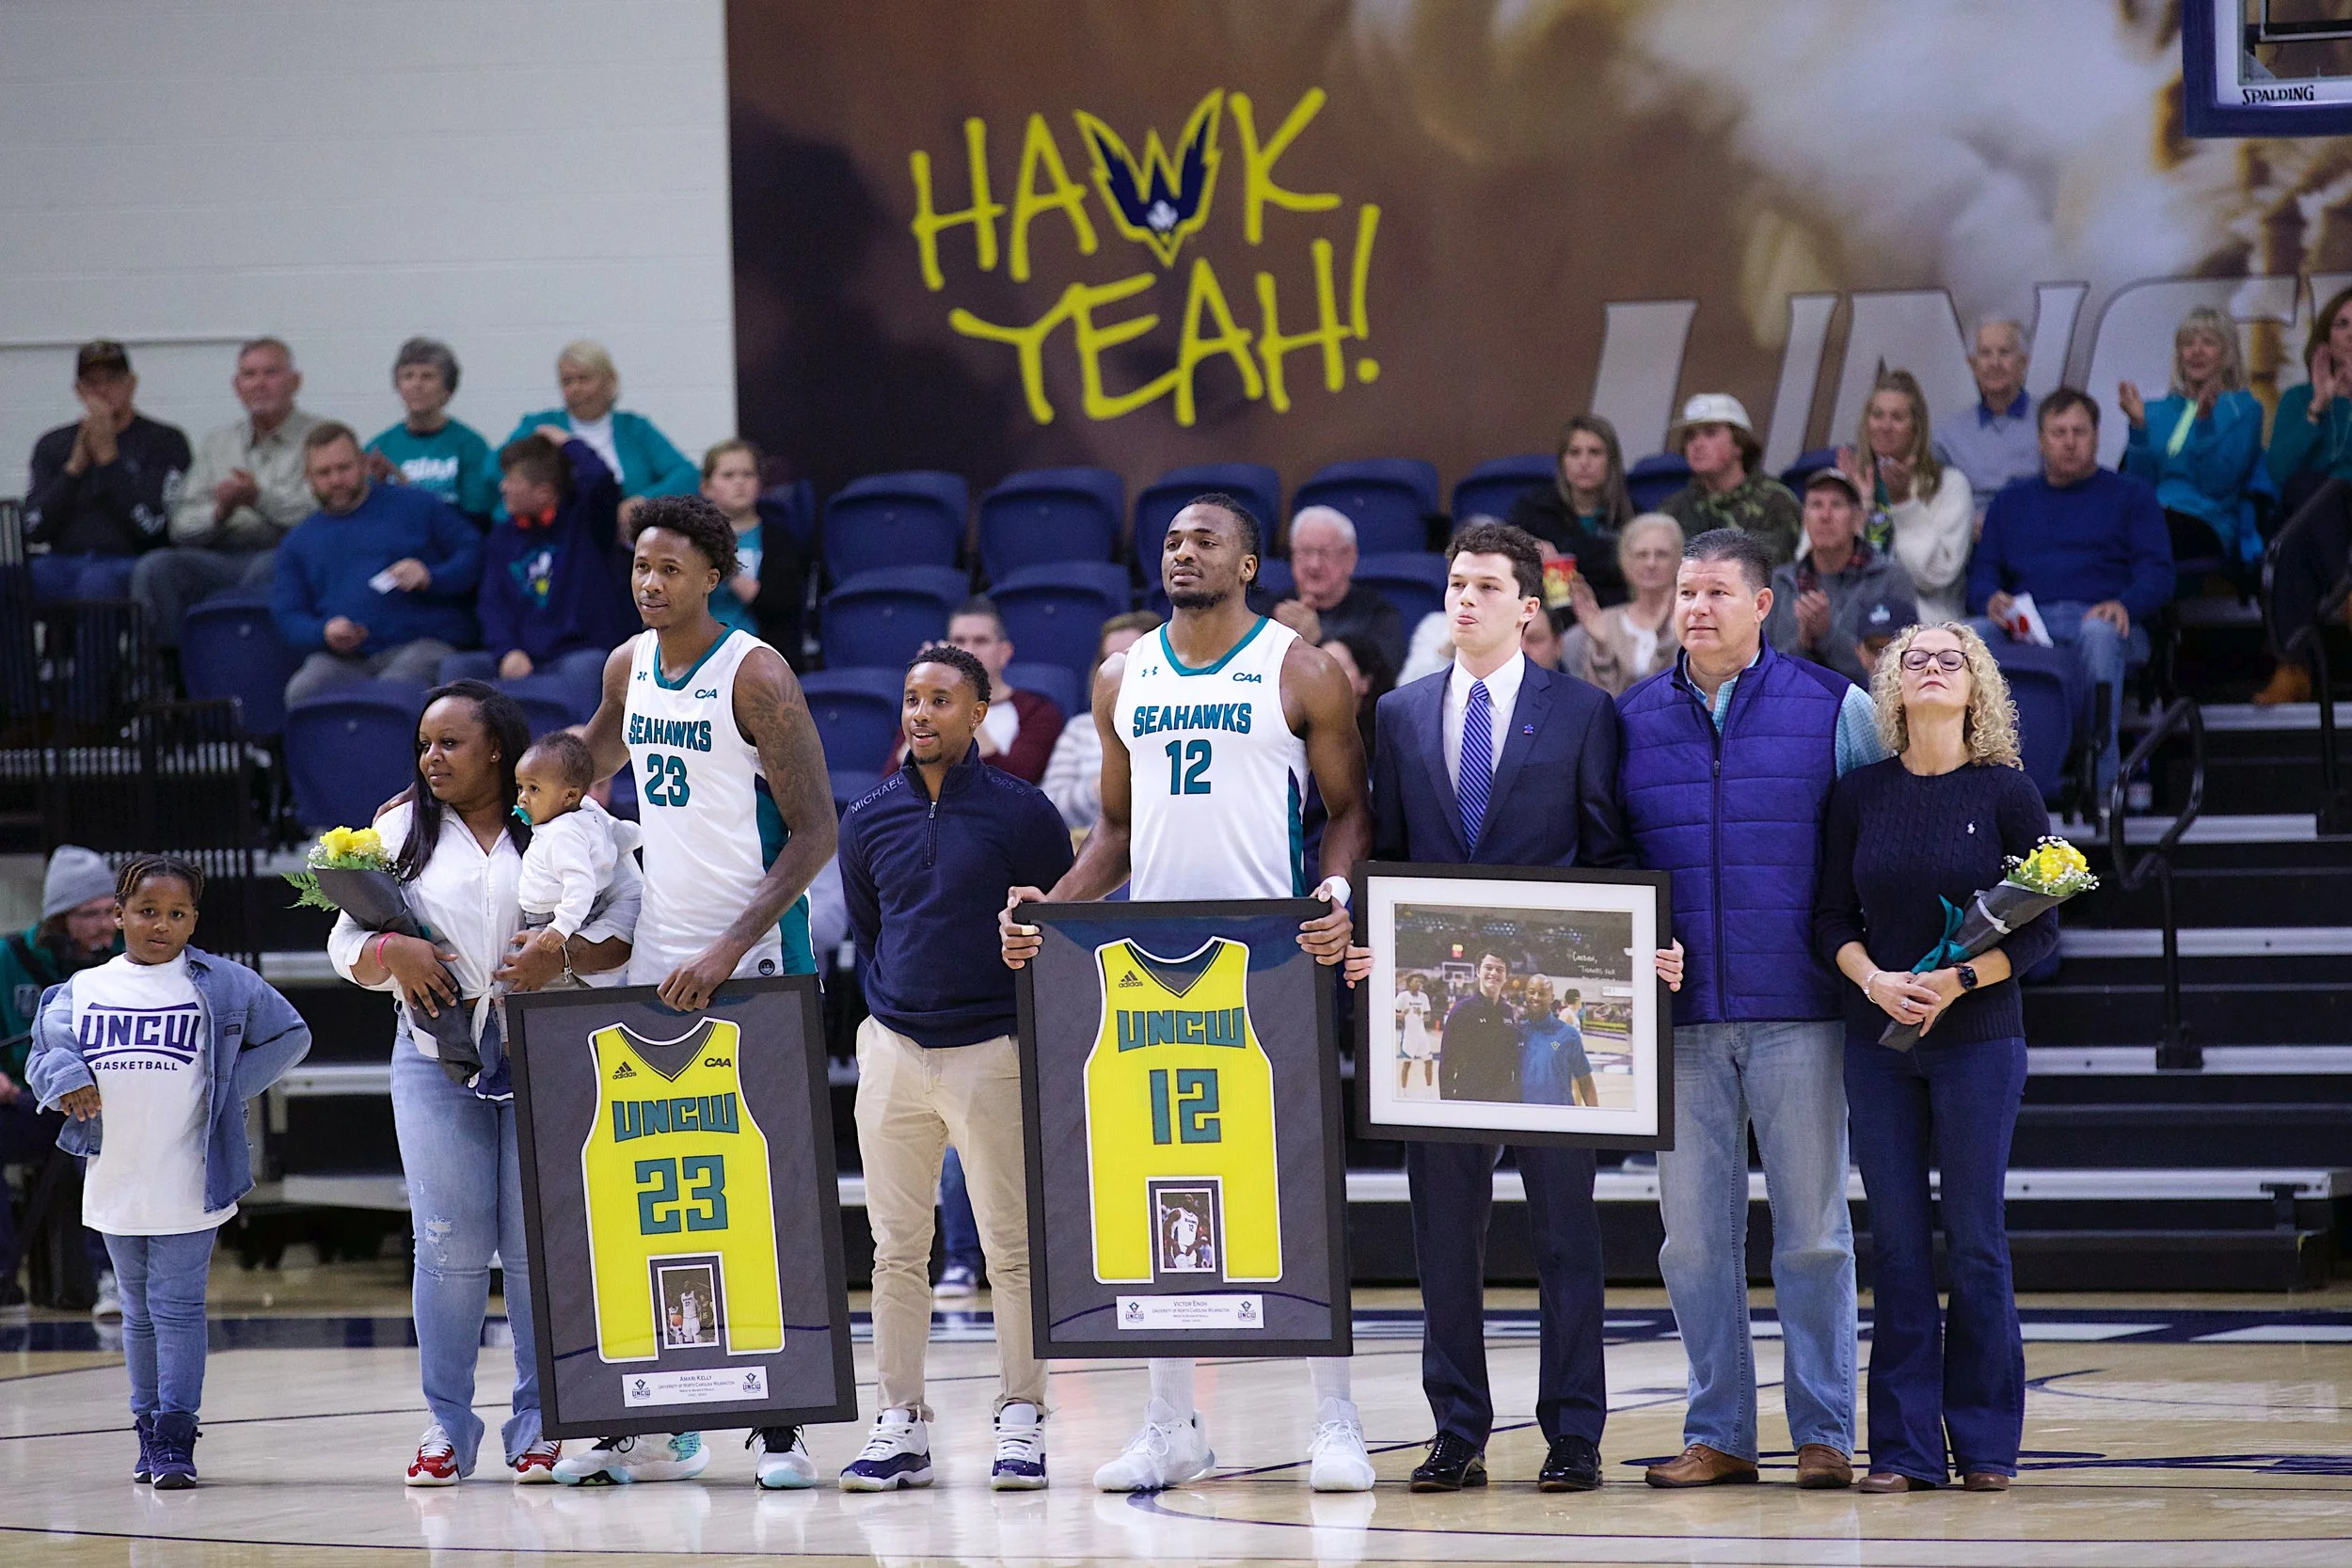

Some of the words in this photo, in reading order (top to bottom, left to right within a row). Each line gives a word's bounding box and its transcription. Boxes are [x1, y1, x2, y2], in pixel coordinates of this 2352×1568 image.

[2242, 85, 2314, 105] SPALDING
[911, 87, 1342, 291] HAWK
[948, 203, 1380, 426] YEAH!
[694, 689, 718, 700] CAA
[1232, 672, 1263, 684] CAA
[628, 712, 712, 752] SEAHAWKS
[1132, 703, 1252, 738] SEAHAWKS
[644, 753, 691, 807] 23
[1165, 738, 1213, 796] 12
[850, 776, 905, 815] MICHAEL
[79, 1014, 201, 1053] UNCW
[1117, 1006, 1247, 1053] UNCW
[94, 1061, 178, 1071] BASKETBALL
[612, 1070, 637, 1080] adidas
[704, 1057, 732, 1068] CAA
[612, 1092, 739, 1143] UNCW
[1149, 1068, 1222, 1146] 12
[634, 1154, 728, 1236] 23
[742, 1382, 761, 1391] UNCW
